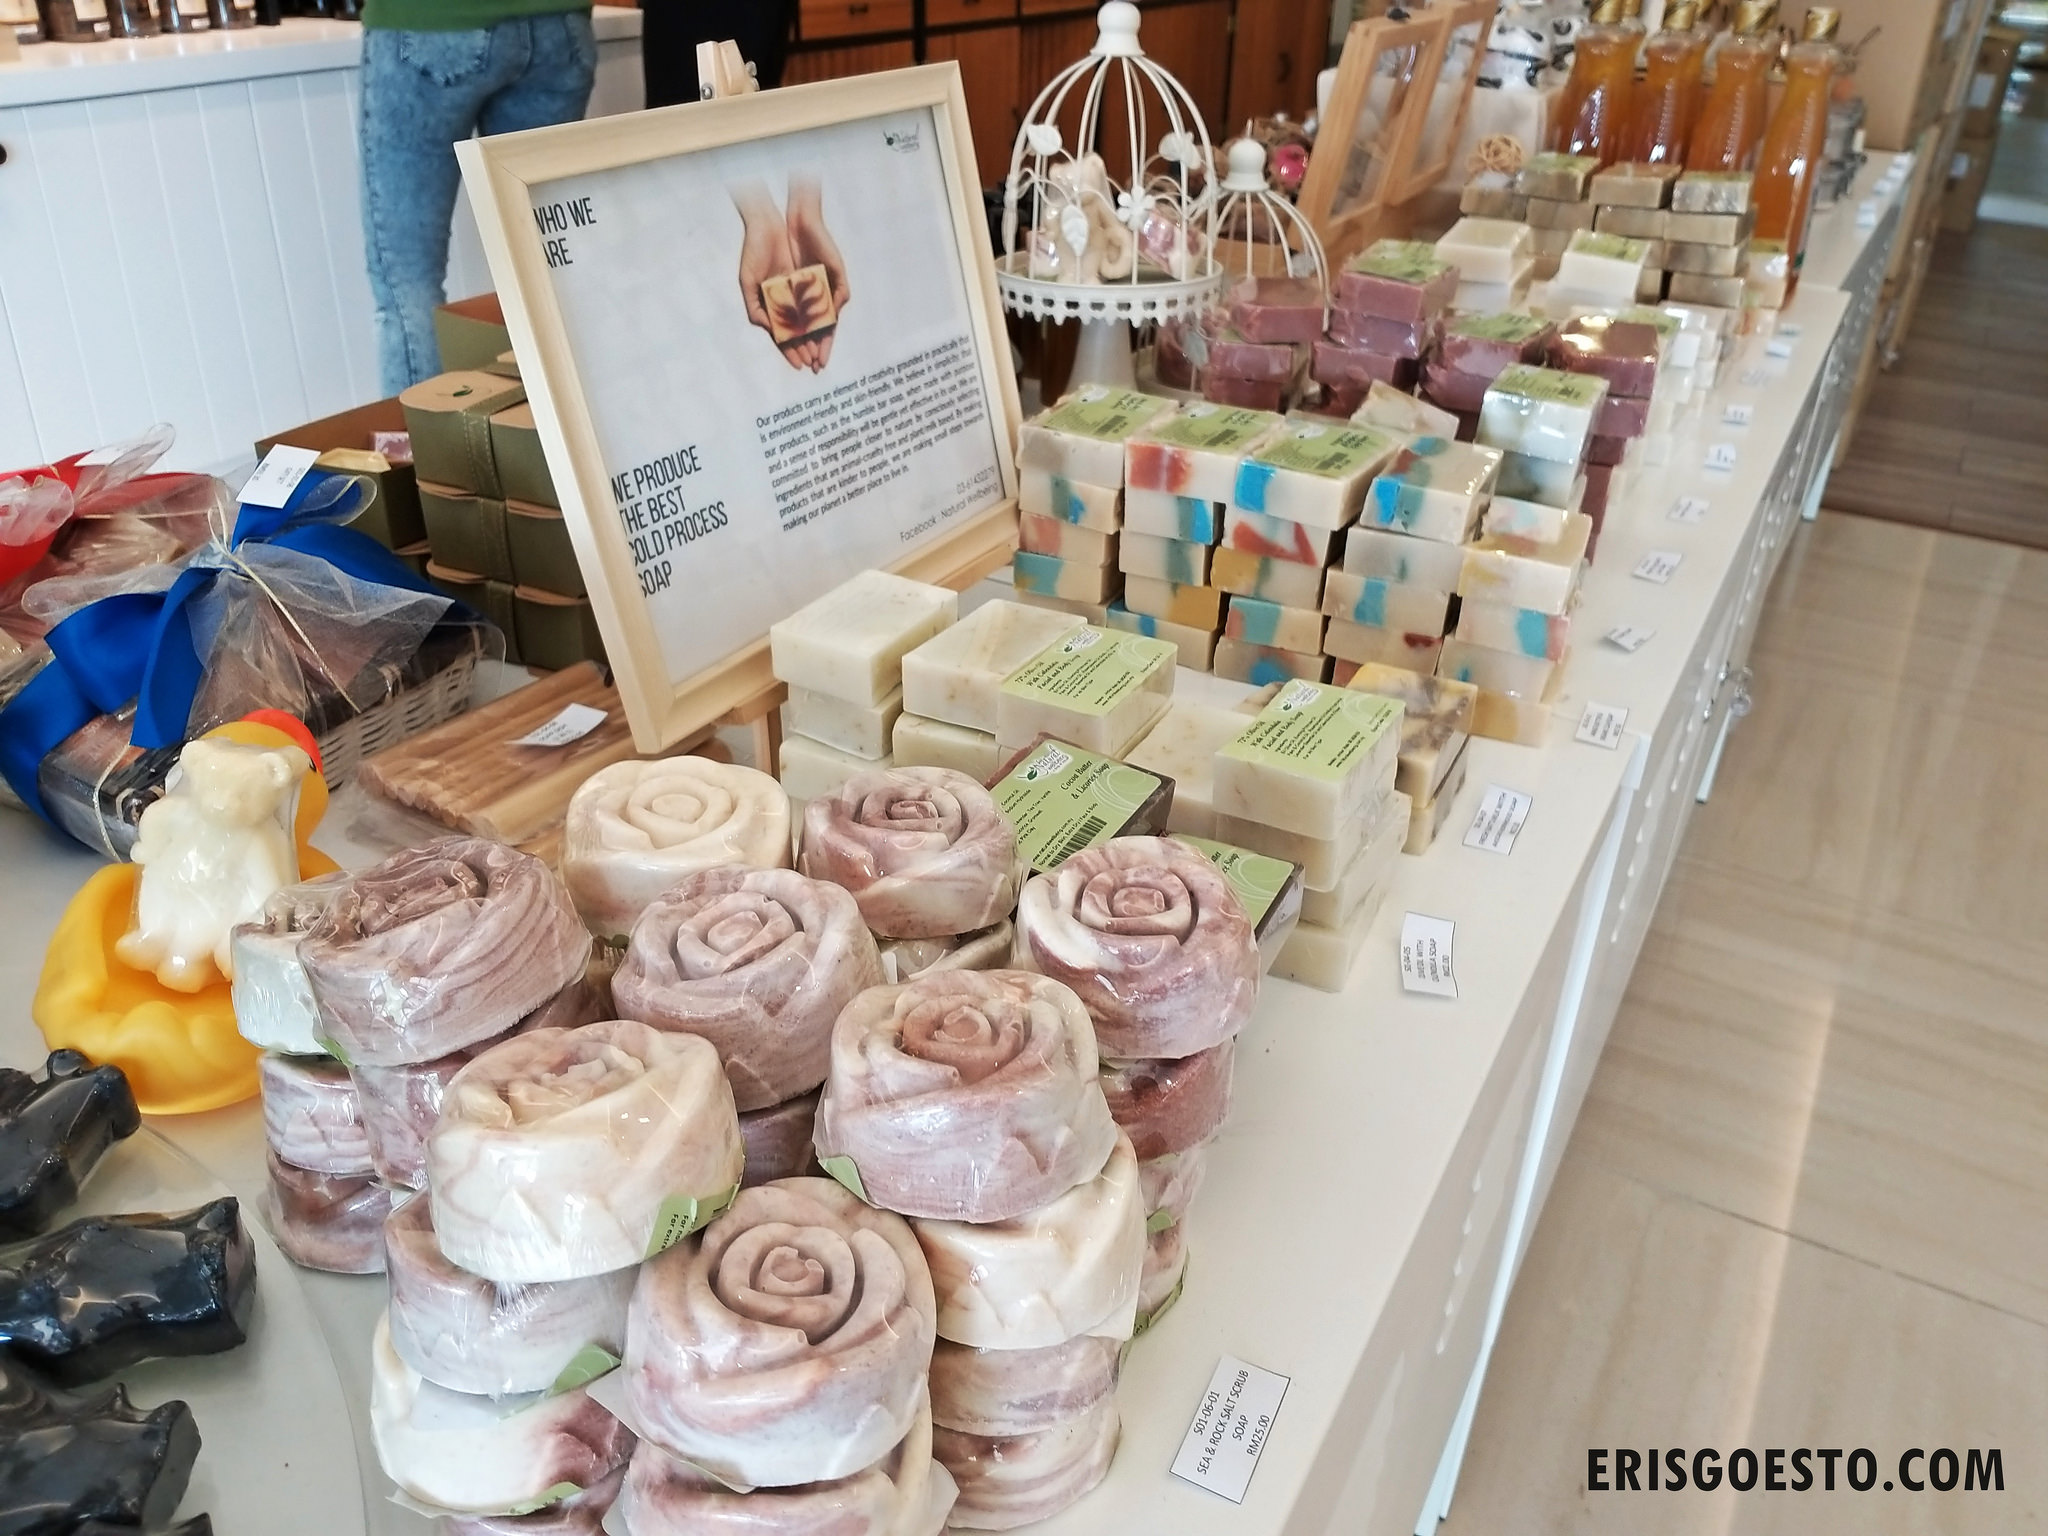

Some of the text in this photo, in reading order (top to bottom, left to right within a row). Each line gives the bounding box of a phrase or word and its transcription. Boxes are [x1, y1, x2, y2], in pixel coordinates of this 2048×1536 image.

[567, 197, 596, 227] WE
[756, 417, 770, 428] Our
[773, 404, 803, 423] products
[804, 397, 822, 409] carry
[833, 380, 858, 398] element
[868, 366, 894, 384] creativity
[897, 354, 923, 374] grounded
[765, 448, 776, 458] our
[813, 424, 829, 438] such
[840, 416, 850, 426] the
[852, 406, 876, 420] humble
[878, 400, 888, 410] bar
[906, 386, 920, 396] when
[924, 378, 938, 388] made
[940, 370, 952, 382] with
[769, 404, 838, 440] environment-friendly
[841, 398, 852, 409] and
[905, 369, 925, 382] believe
[768, 460, 782, 474] and
[789, 450, 808, 464] sense
[818, 428, 858, 452] responsibility
[860, 421, 870, 432] will
[881, 411, 898, 426] gentle
[900, 405, 908, 416] yet
[910, 395, 932, 411] effective
[772, 462, 808, 488] committed
[821, 452, 839, 466] bring
[841, 440, 862, 458] people
[865, 432, 882, 446] closer
[894, 418, 912, 432] nature
[775, 480, 812, 503] ingredients
[814, 472, 828, 484] that
[830, 468, 840, 478] are
[841, 448, 883, 472] animal-cruelty
[885, 442, 896, 451] free
[898, 434, 908, 446] and
[964, 400, 982, 413] making
[634, 445, 702, 495] PRODUCE
[780, 497, 809, 518] products
[810, 489, 824, 502] that
[827, 484, 836, 494] are
[838, 474, 858, 488] kinder
[902, 448, 911, 458] are
[913, 438, 933, 452] making
[934, 428, 947, 442] small
[950, 424, 962, 434] steps
[647, 486, 686, 524] BEST
[784, 514, 808, 532] making
[808, 508, 819, 520] our
[821, 498, 841, 514] planet
[847, 486, 866, 500] better
[867, 478, 882, 492] place
[890, 468, 901, 478] live
[900, 515, 936, 541] Facebook
[941, 498, 966, 519] Natural
[664, 501, 728, 550] PROCESS
[1061, 760, 1092, 790] Cocoa Butter
[1076, 774, 1098, 794] Licorice
[1094, 763, 1110, 775] Soap
[670, 1214, 678, 1228] For
[680, 1215, 688, 1228] For
[1194, 1391, 1220, 1436] S01-06-01
[1197, 1370, 1249, 1474] SEA & ROCK SALT SCRUB
[1232, 1414, 1248, 1440] SOAP
[1247, 1414, 1270, 1456] RM25.00
